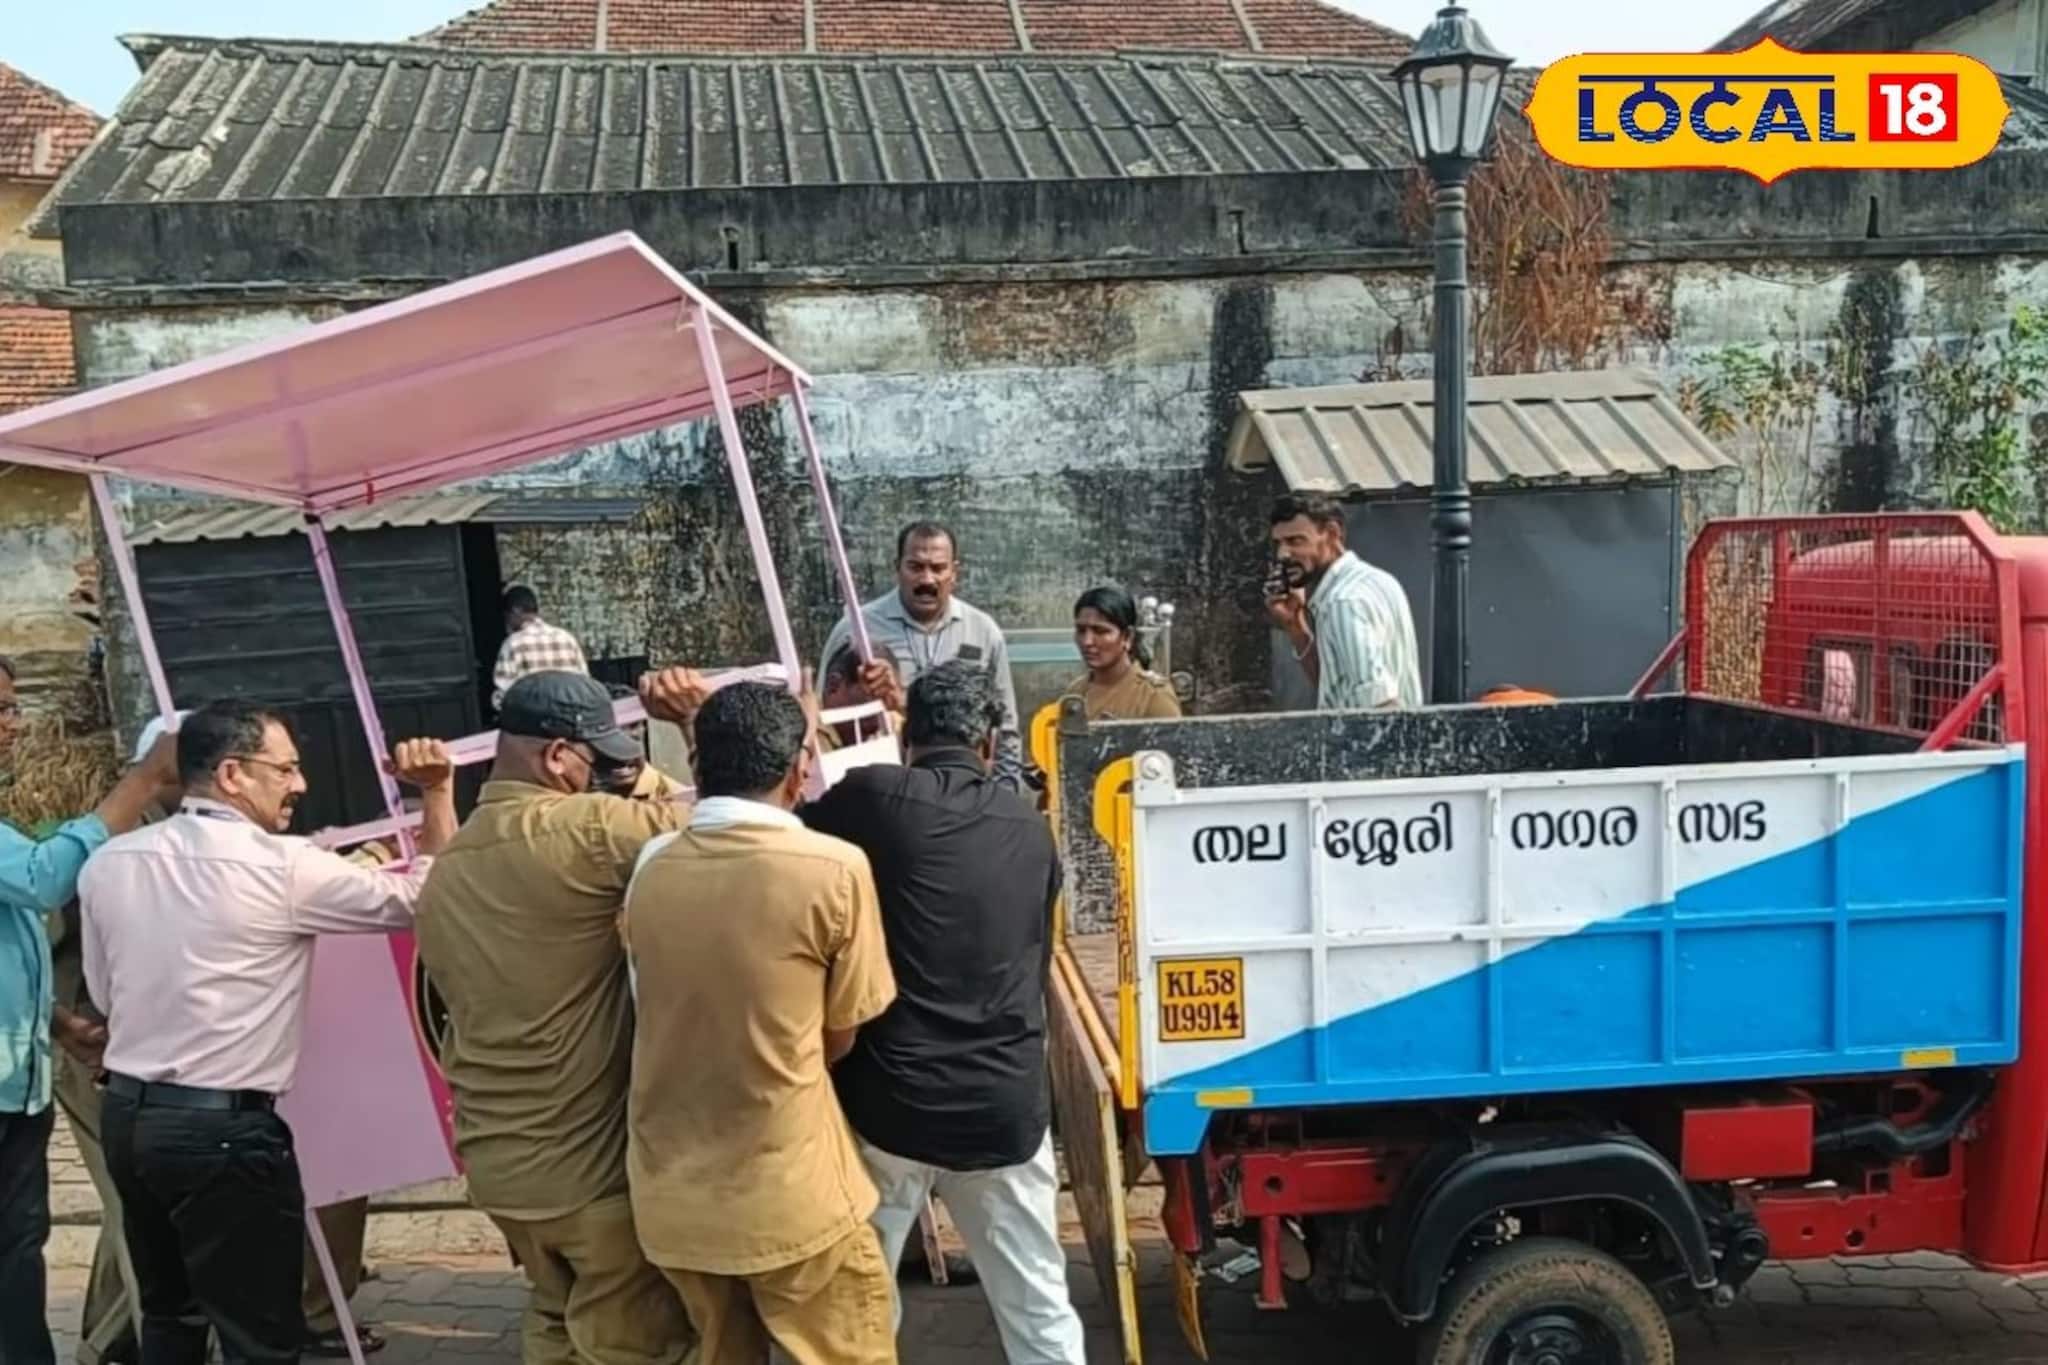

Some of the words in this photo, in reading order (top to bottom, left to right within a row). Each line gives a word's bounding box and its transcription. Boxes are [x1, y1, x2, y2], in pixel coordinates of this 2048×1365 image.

[1192, 822, 1288, 864] തല
[1510, 805, 1639, 851] നഗര
[1677, 800, 1767, 843] സഭ
[1165, 969, 1236, 997] KL58
